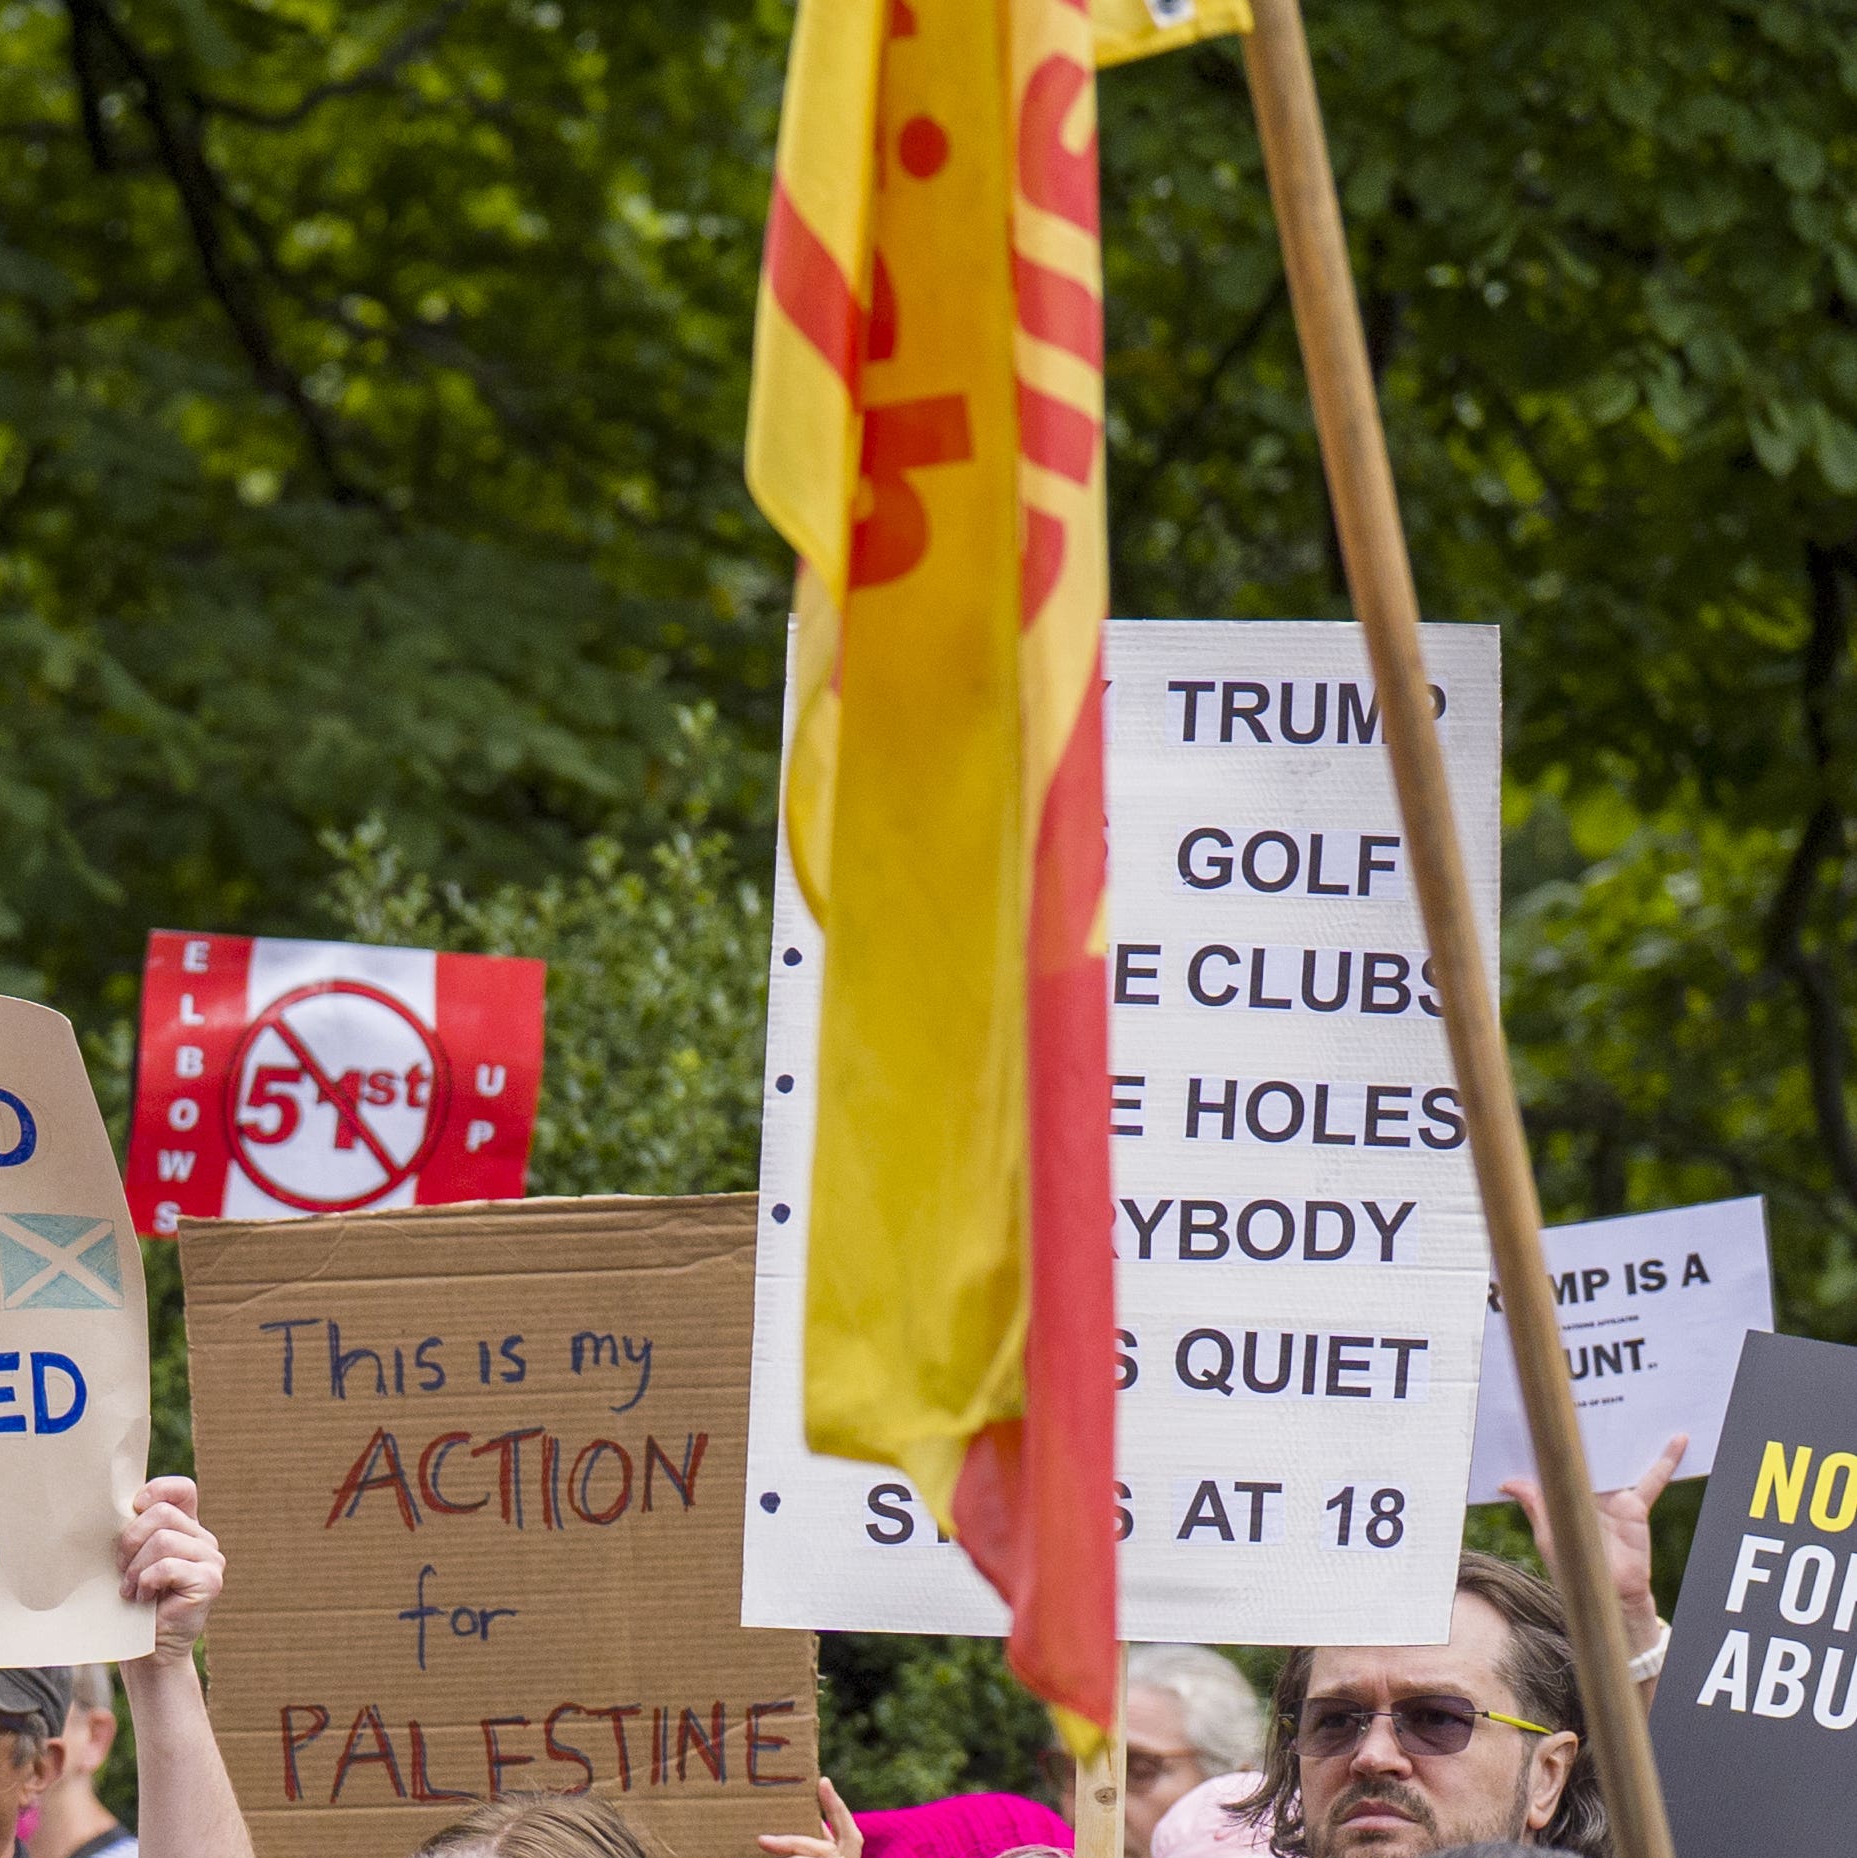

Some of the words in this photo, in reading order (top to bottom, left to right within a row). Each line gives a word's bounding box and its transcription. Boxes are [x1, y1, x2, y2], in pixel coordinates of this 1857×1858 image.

[1177, 827, 1401, 897] GOLF
[1185, 1077, 1467, 1150] HOLES
[1624, 1259, 1668, 1295] IS
[1681, 1252, 1710, 1287] A
[571, 1330, 653, 1413] my
[1175, 1327, 1429, 1400] QUIET
[1564, 1338, 1645, 1380] UNT
[324, 1426, 709, 1531] ACTION
[1176, 1480, 1283, 1544] AT
[1325, 1484, 1407, 1550] 18
[1749, 1440, 1857, 1533] NO
[398, 1564, 519, 1671] for
[280, 1700, 808, 1804] PALESTINE
